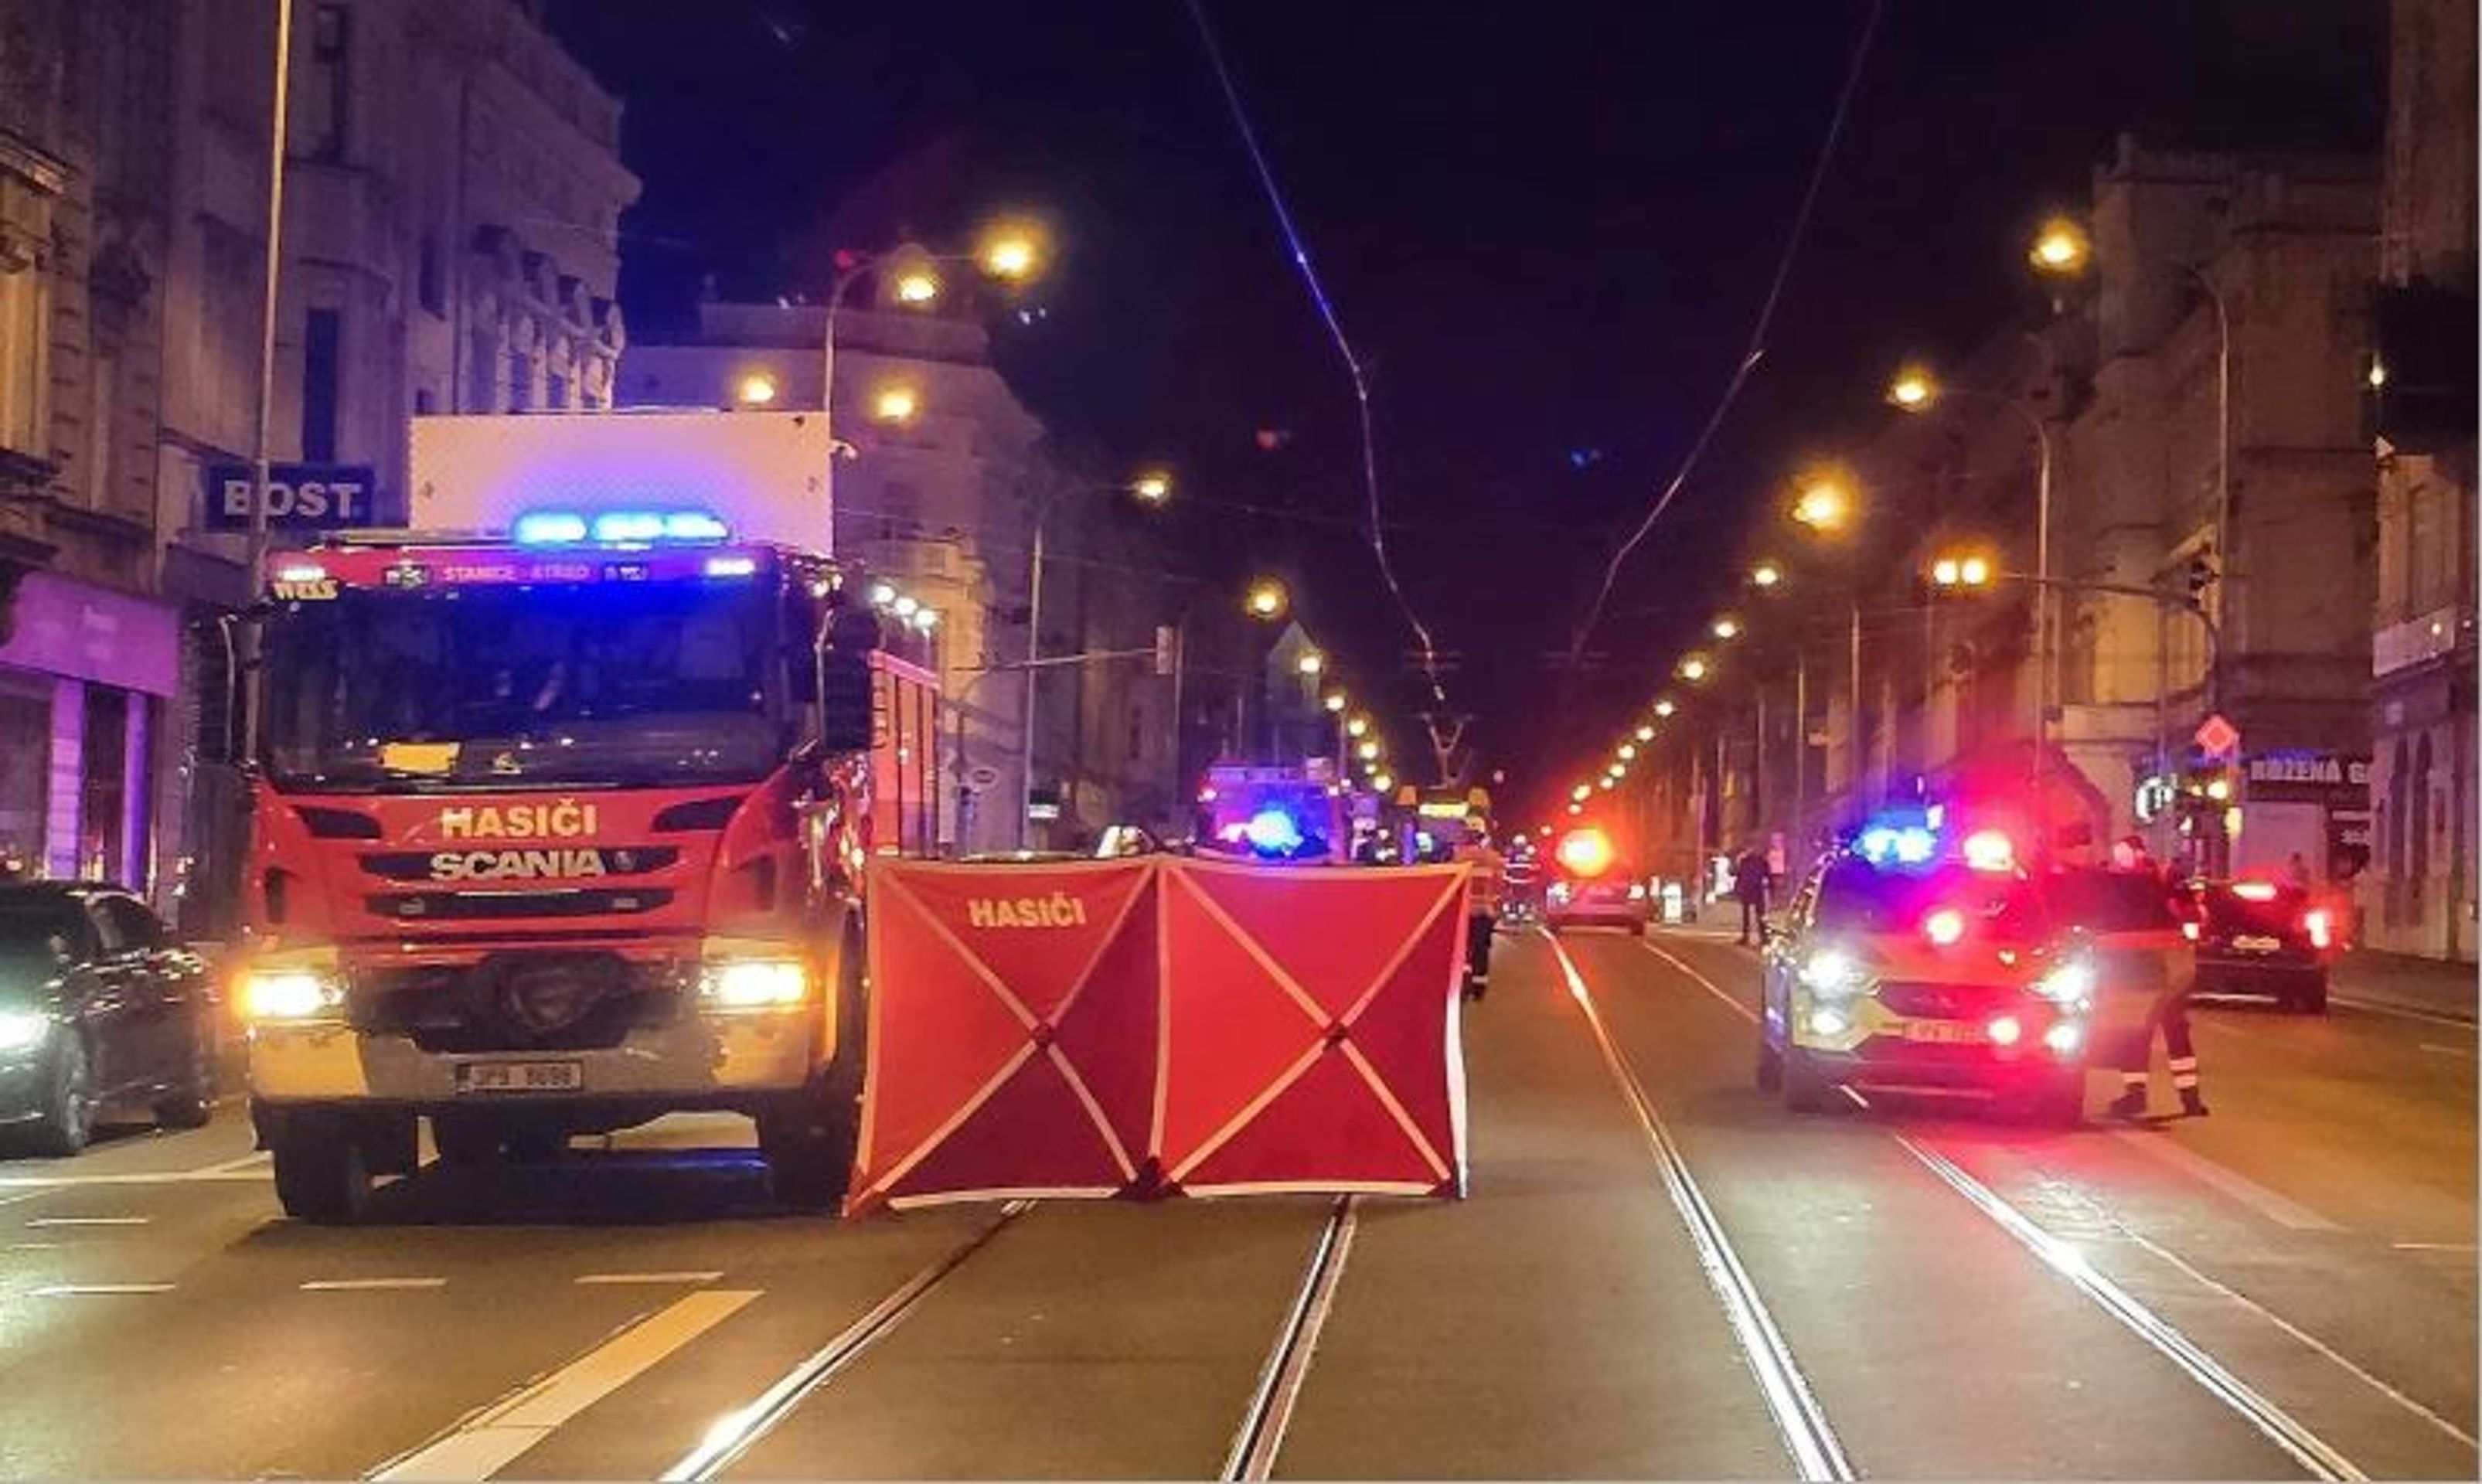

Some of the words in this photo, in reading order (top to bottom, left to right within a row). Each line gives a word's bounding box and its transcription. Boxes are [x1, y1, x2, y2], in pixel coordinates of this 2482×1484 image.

[223, 479, 362, 519] BOST
[441, 798, 598, 838] HASIČI
[429, 849, 606, 880] SCANIA
[968, 891, 1087, 928] HASIČI
